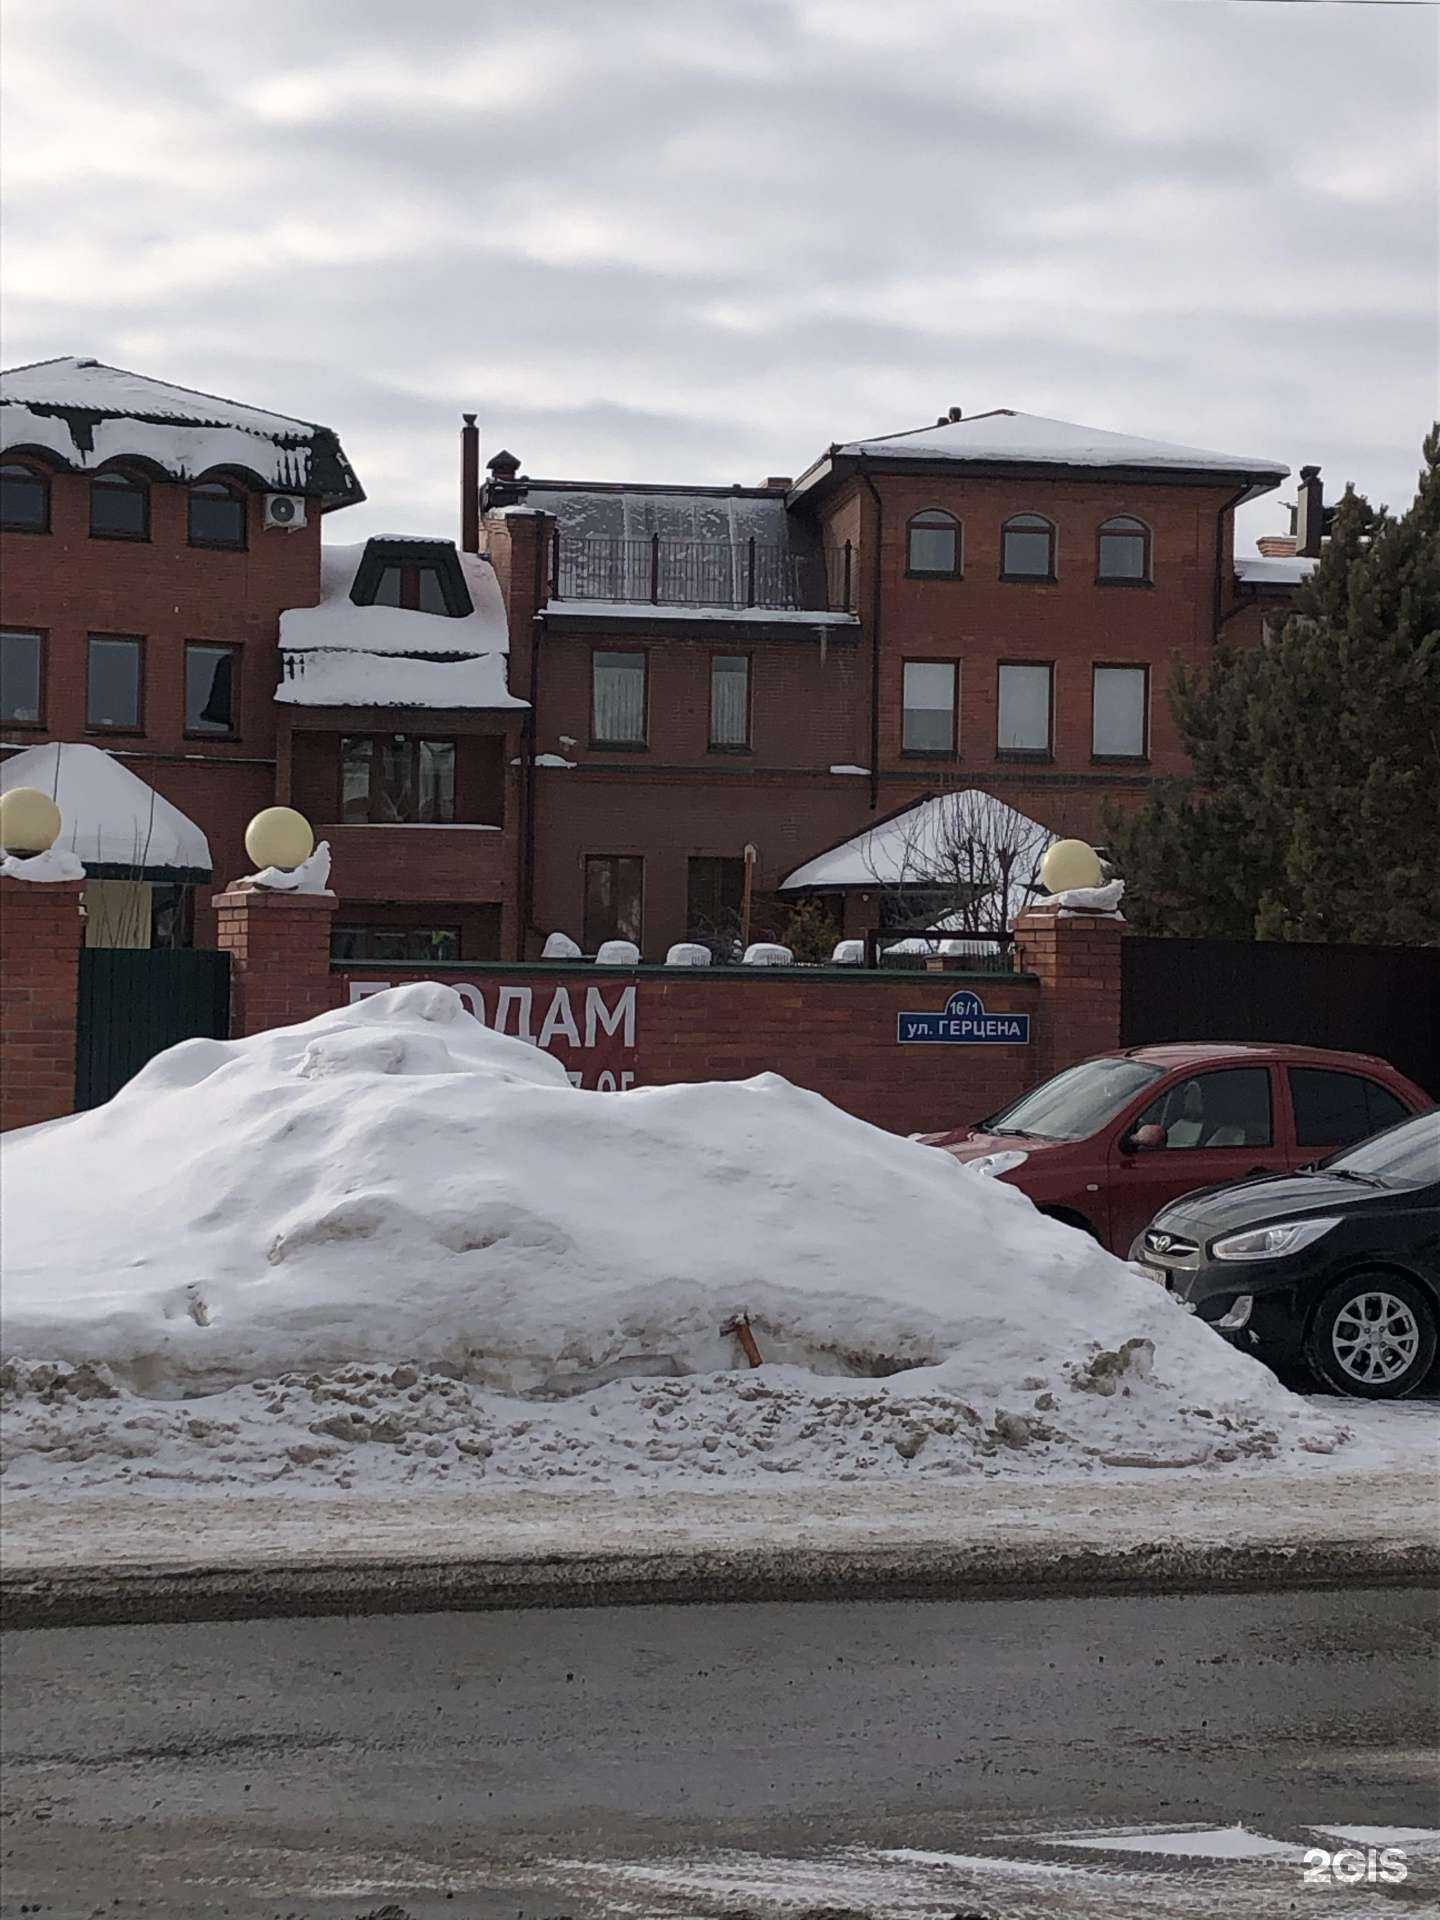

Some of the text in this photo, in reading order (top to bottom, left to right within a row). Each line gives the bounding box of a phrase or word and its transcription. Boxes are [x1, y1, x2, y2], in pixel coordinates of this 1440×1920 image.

[950, 1001, 978, 1016] 16/1
[907, 1020, 1021, 1038] ул. ГЕРЦЕНА
